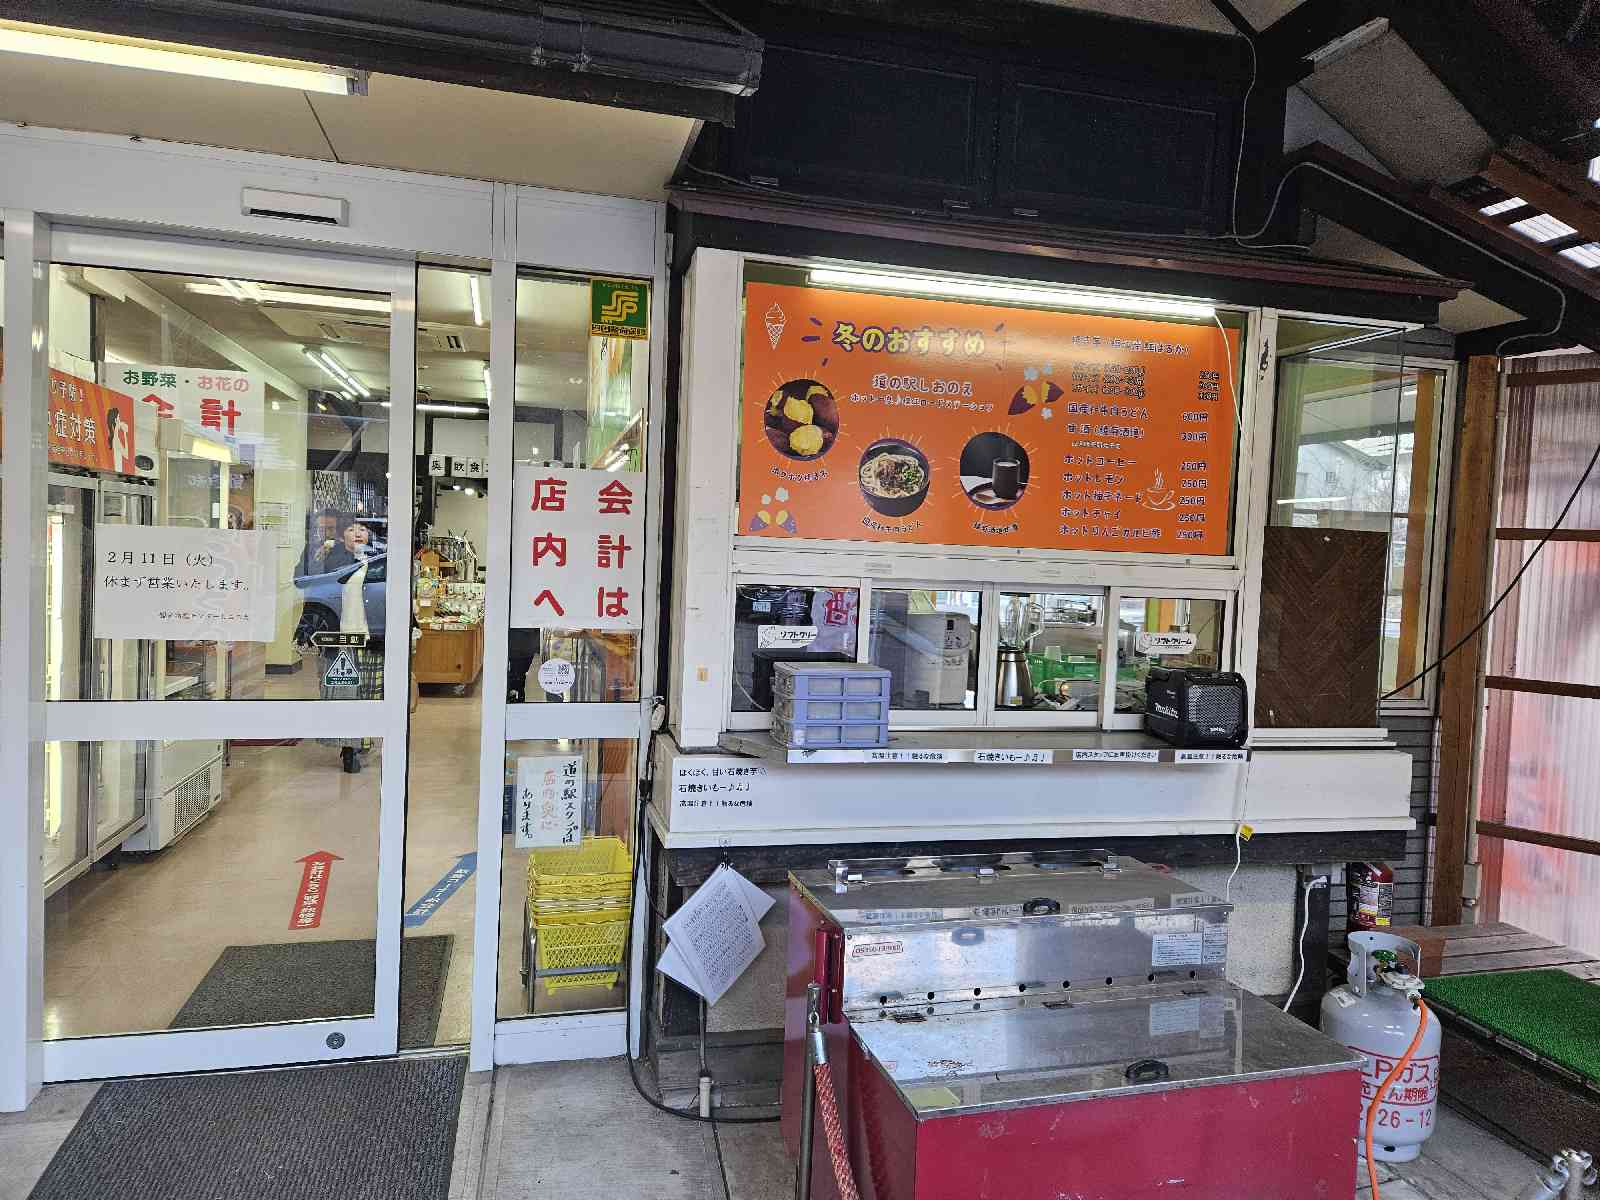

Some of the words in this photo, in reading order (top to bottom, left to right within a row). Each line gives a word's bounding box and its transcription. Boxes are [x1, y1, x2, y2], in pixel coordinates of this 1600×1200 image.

[832, 321, 987, 353] 冬のおすすめ
[123, 369, 249, 393] お野菜・お花の
[873, 373, 974, 397] 道の駅しおのえ
[1063, 454, 1137, 467] ホットコーヒー
[1062, 472, 1127, 485] ホットレモン
[1060, 507, 1121, 520] ホットチャイ
[530, 478, 567, 617] 店内へ
[597, 479, 633, 618] 会計は
[104, 576, 250, 591] 休まず営業いたします。
[560, 760, 579, 845] 道の駅スタンプは
